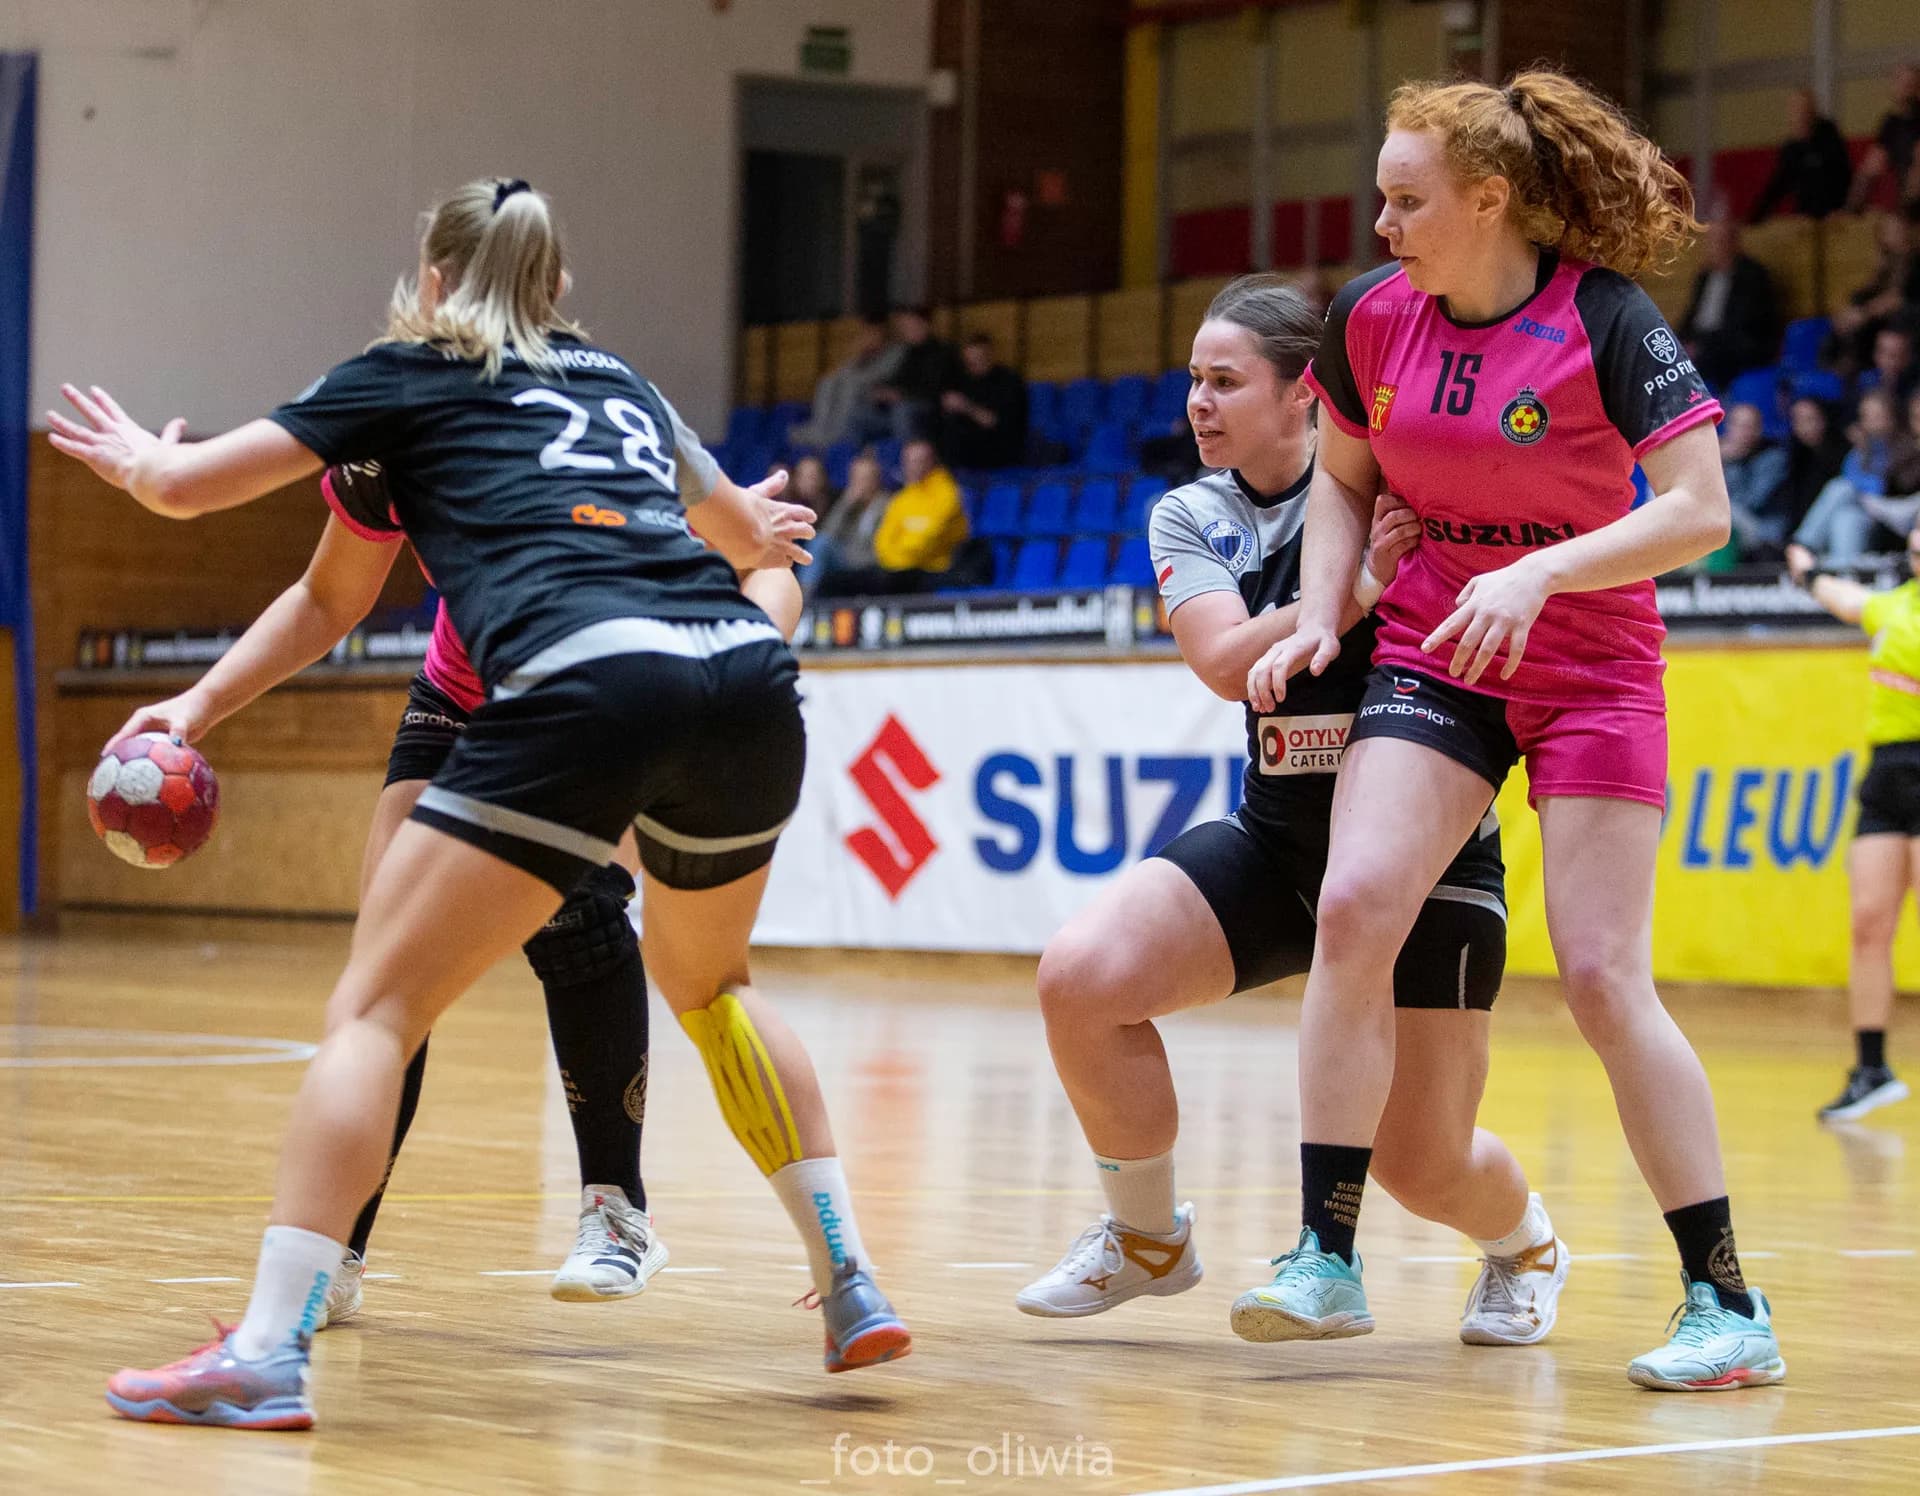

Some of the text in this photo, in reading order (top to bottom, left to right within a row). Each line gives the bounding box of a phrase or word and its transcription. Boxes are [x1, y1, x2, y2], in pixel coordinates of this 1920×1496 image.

[1430, 350, 1484, 416] 15
[511, 388, 677, 492] 28
[1423, 517, 1576, 547] SUZUKI
[1360, 703, 1444, 727] karabela
[1291, 751, 1344, 768] CATERI
[972, 751, 1247, 876] SUZ
[1661, 752, 1853, 869] LEW
[812, 1192, 848, 1265] empa
